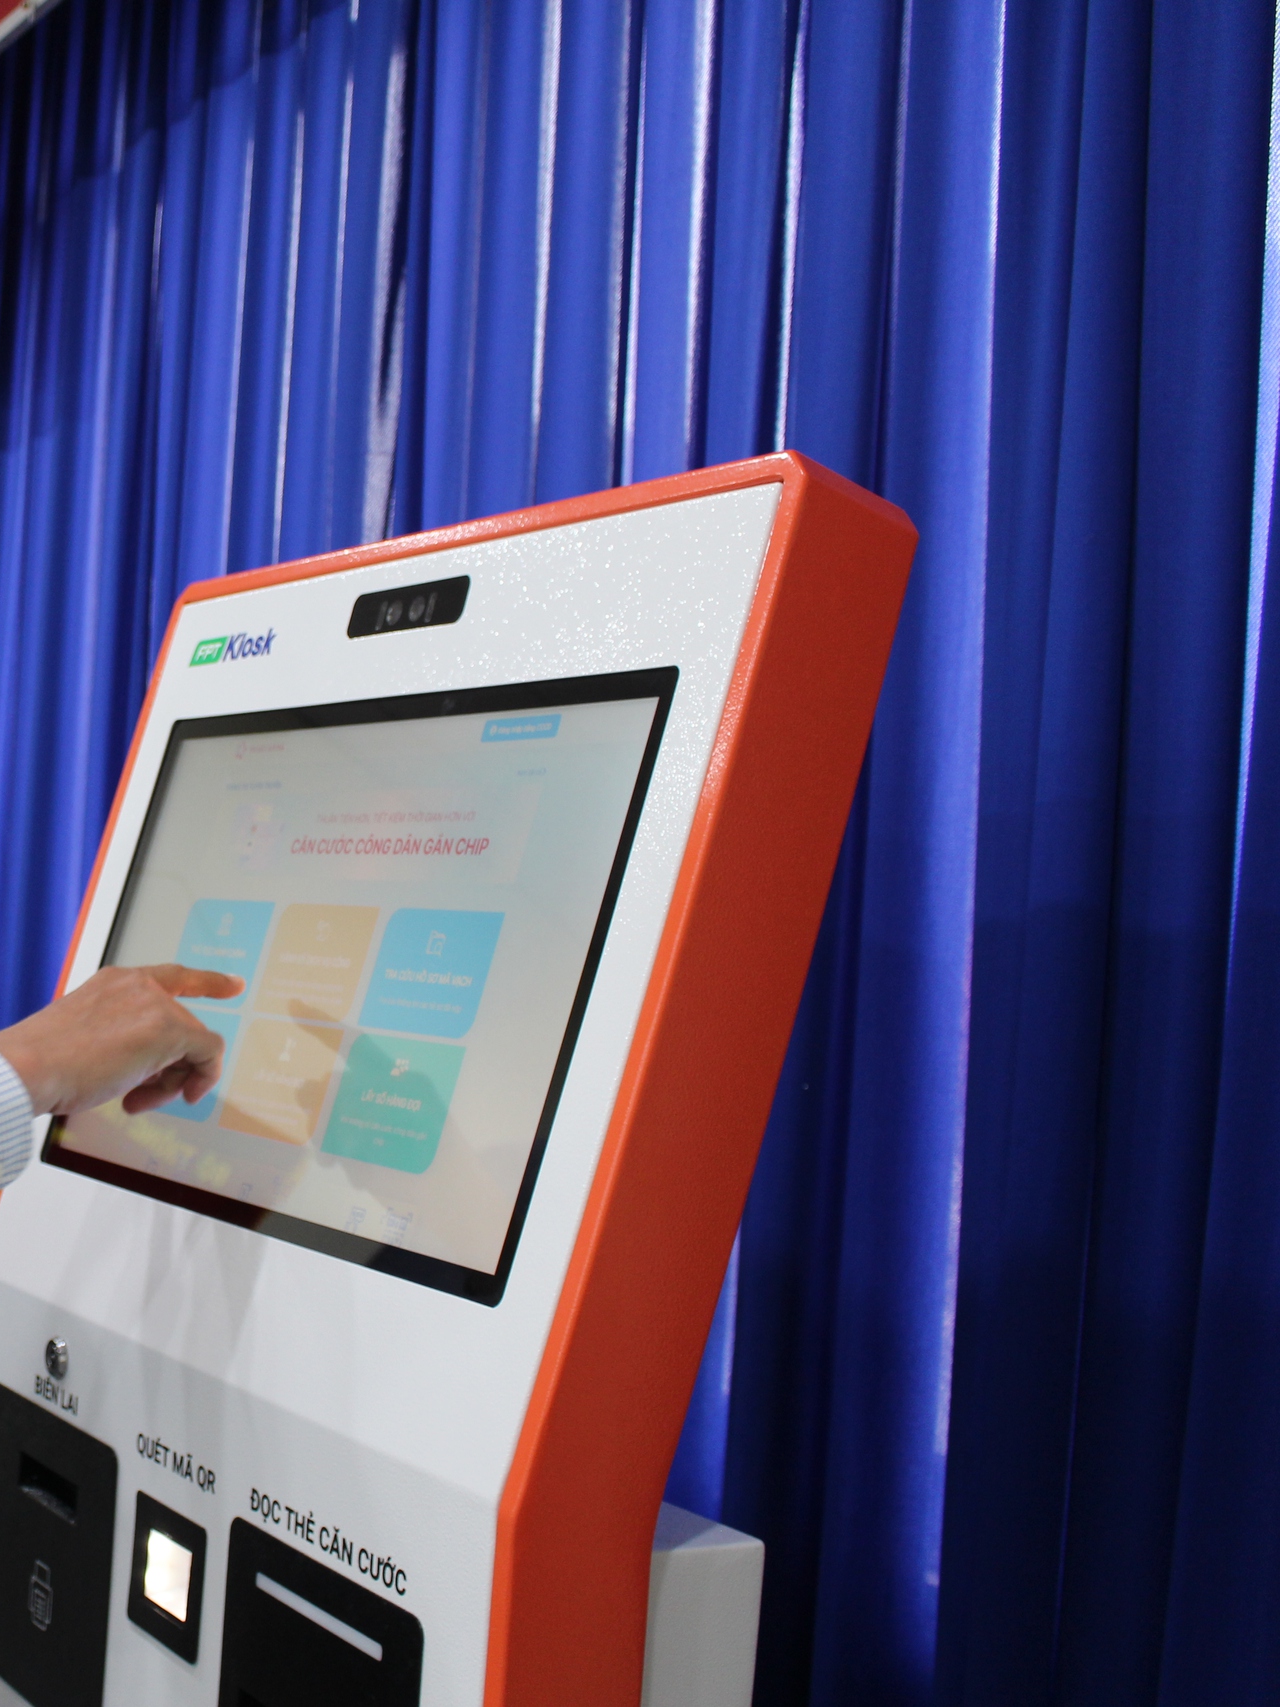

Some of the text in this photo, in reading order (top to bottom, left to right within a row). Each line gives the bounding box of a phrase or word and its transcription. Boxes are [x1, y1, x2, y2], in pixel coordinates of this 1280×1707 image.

[195, 627, 277, 663] FPT Kiosk
[290, 833, 490, 856] CĂN CƯỚC CÔNG DÂN GẮN CHIP
[34, 1374, 79, 1417] BIÊN LAI
[137, 1432, 217, 1495] QUÉT MÃ QR
[250, 1487, 408, 1597] ĐỌC THẺ CĂN CƯỚC
